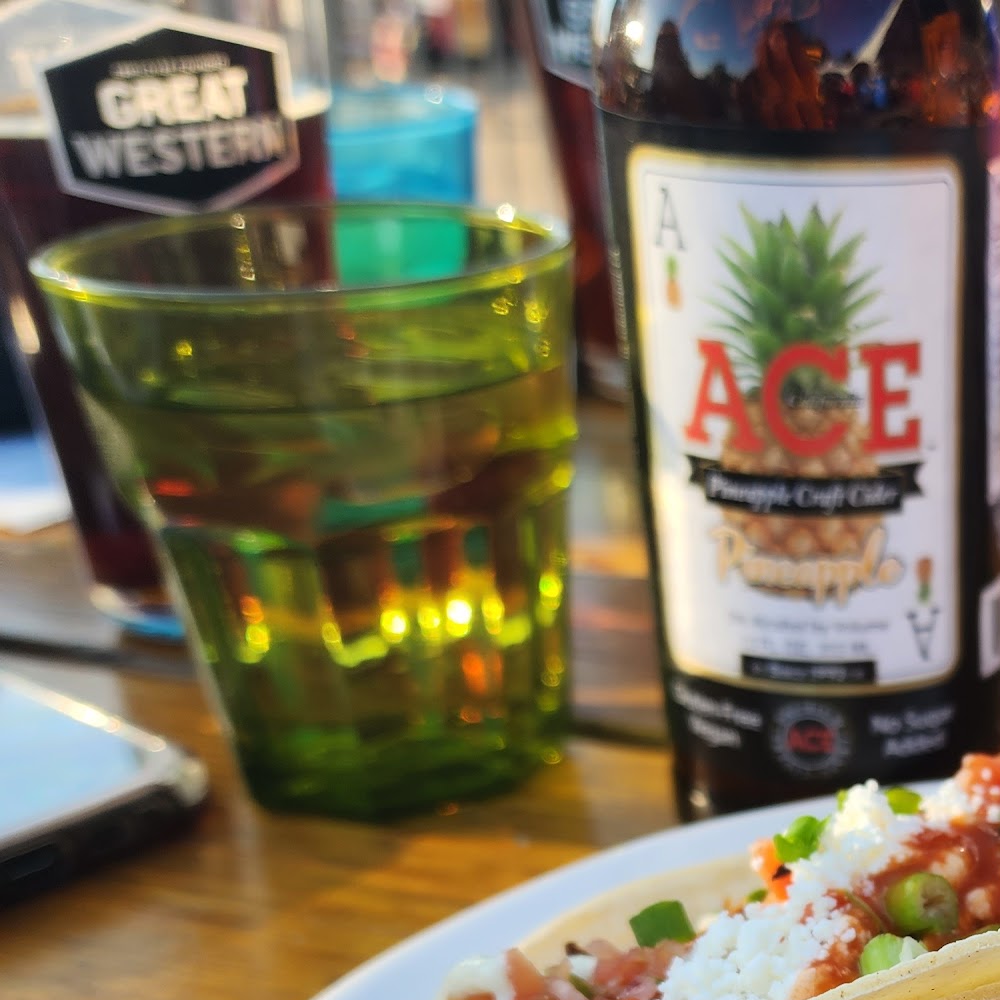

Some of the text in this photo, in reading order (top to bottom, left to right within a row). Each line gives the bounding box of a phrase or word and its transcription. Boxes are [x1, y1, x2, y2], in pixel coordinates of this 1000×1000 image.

[96, 66, 248, 130] GREAT
[69, 113, 287, 179] WESTERN
[655, 184, 687, 252] A
[684, 339, 921, 459] ACE
[709, 524, 904, 609] Pineapple
